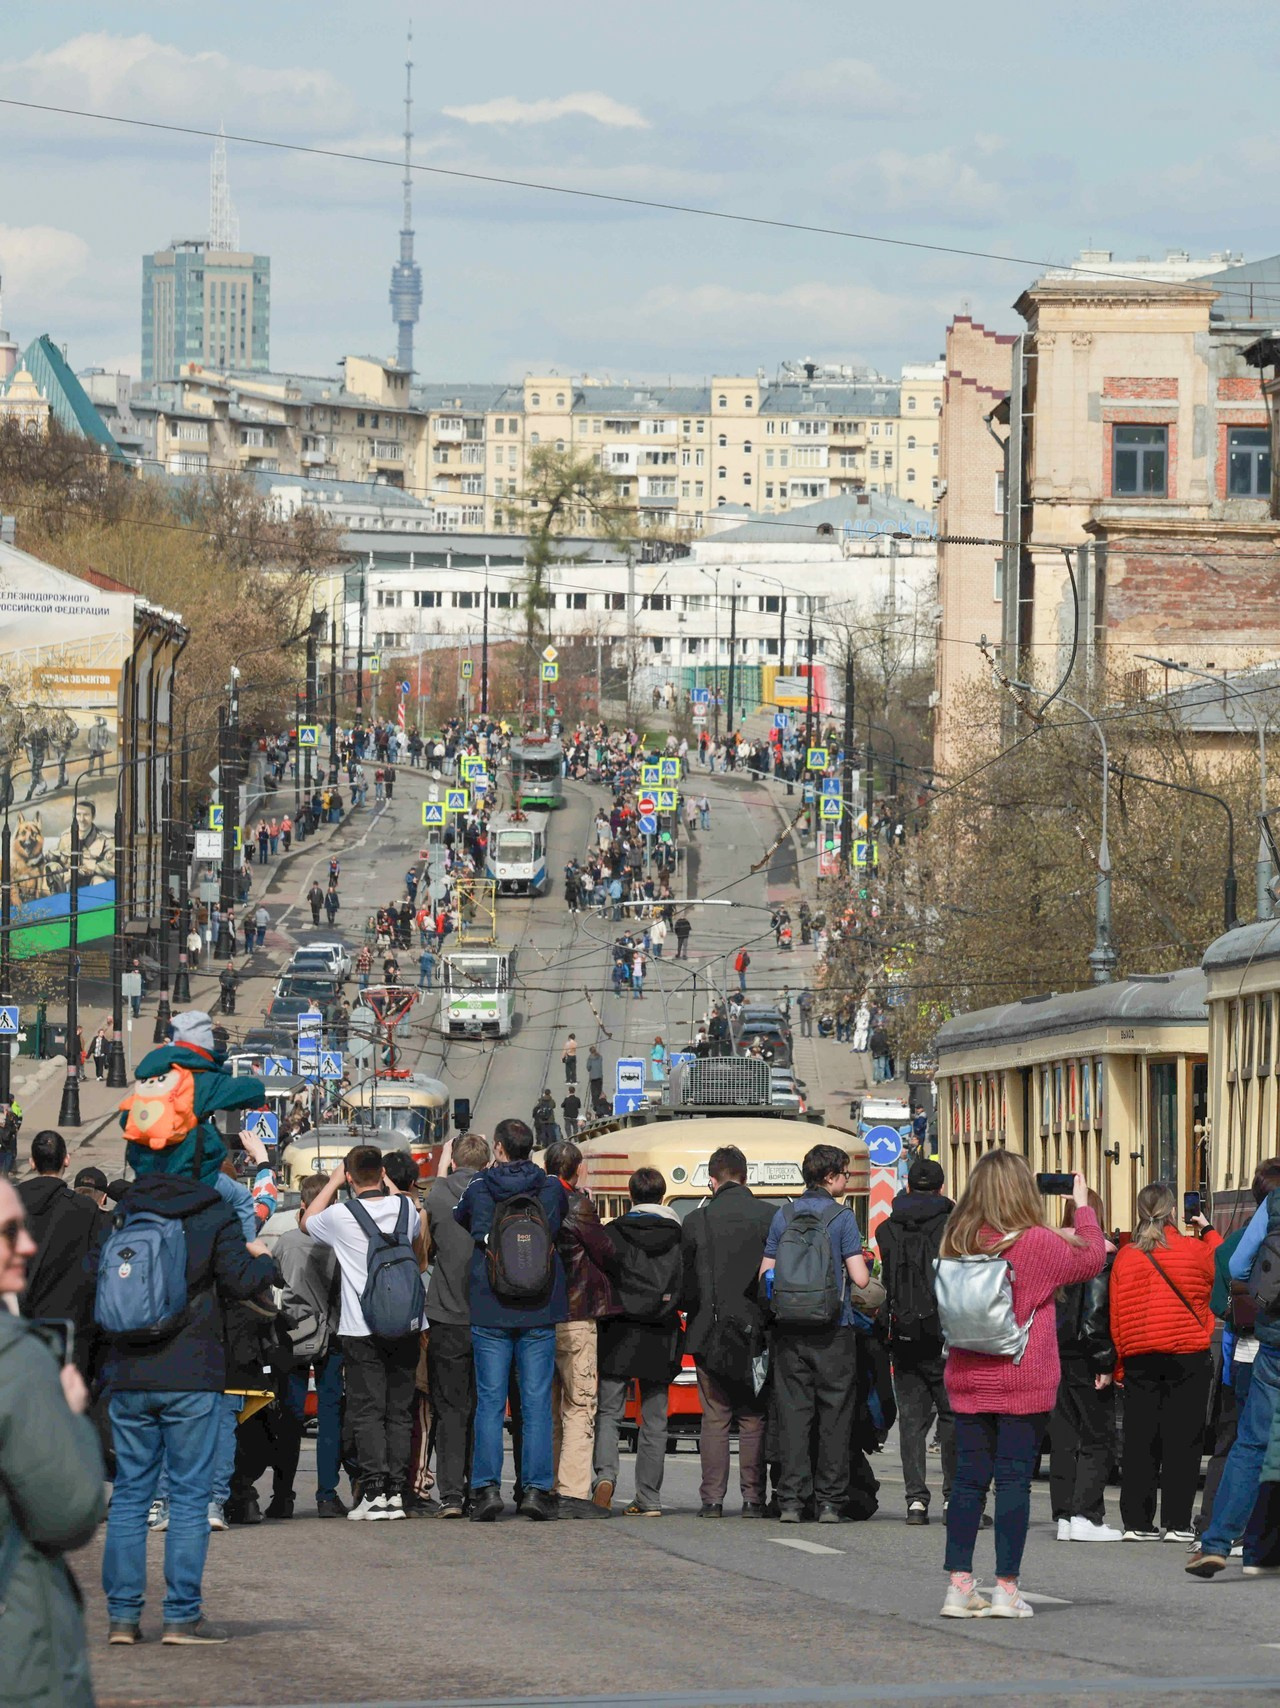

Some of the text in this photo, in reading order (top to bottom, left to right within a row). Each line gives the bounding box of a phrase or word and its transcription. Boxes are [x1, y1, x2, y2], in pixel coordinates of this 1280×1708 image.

[0, 591, 89, 602] ЕЛЕЗНОДОРОЖНОГО
[0, 603, 110, 616] ОССИЙСКОЙ ФЕДЕРАЦИИ
